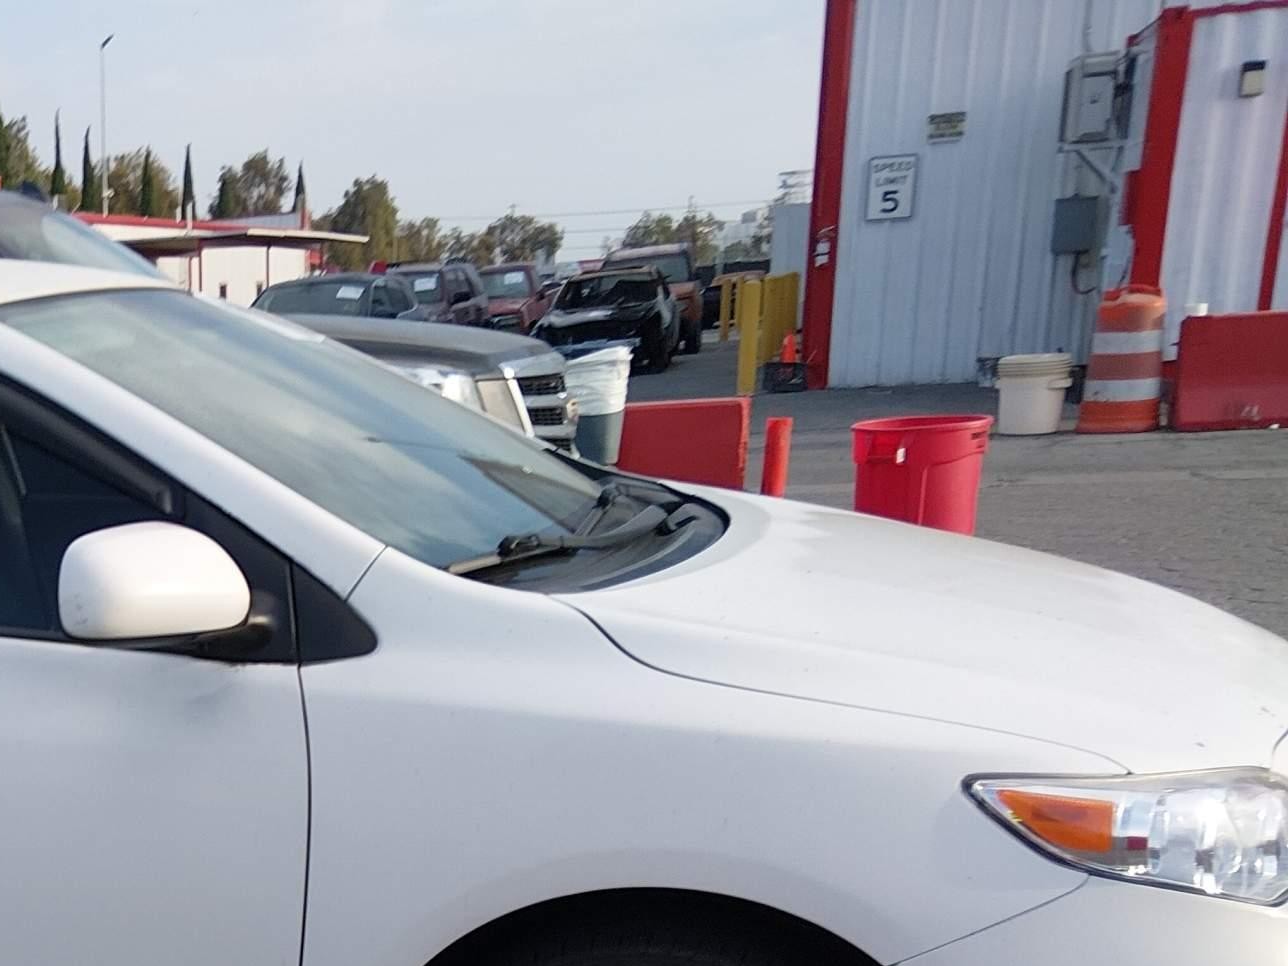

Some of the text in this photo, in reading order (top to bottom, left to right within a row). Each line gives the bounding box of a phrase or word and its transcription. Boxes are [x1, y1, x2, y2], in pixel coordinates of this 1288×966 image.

[873, 161, 912, 173] SPEED
[875, 175, 908, 187] LIMIT
[880, 190, 899, 213] 5
